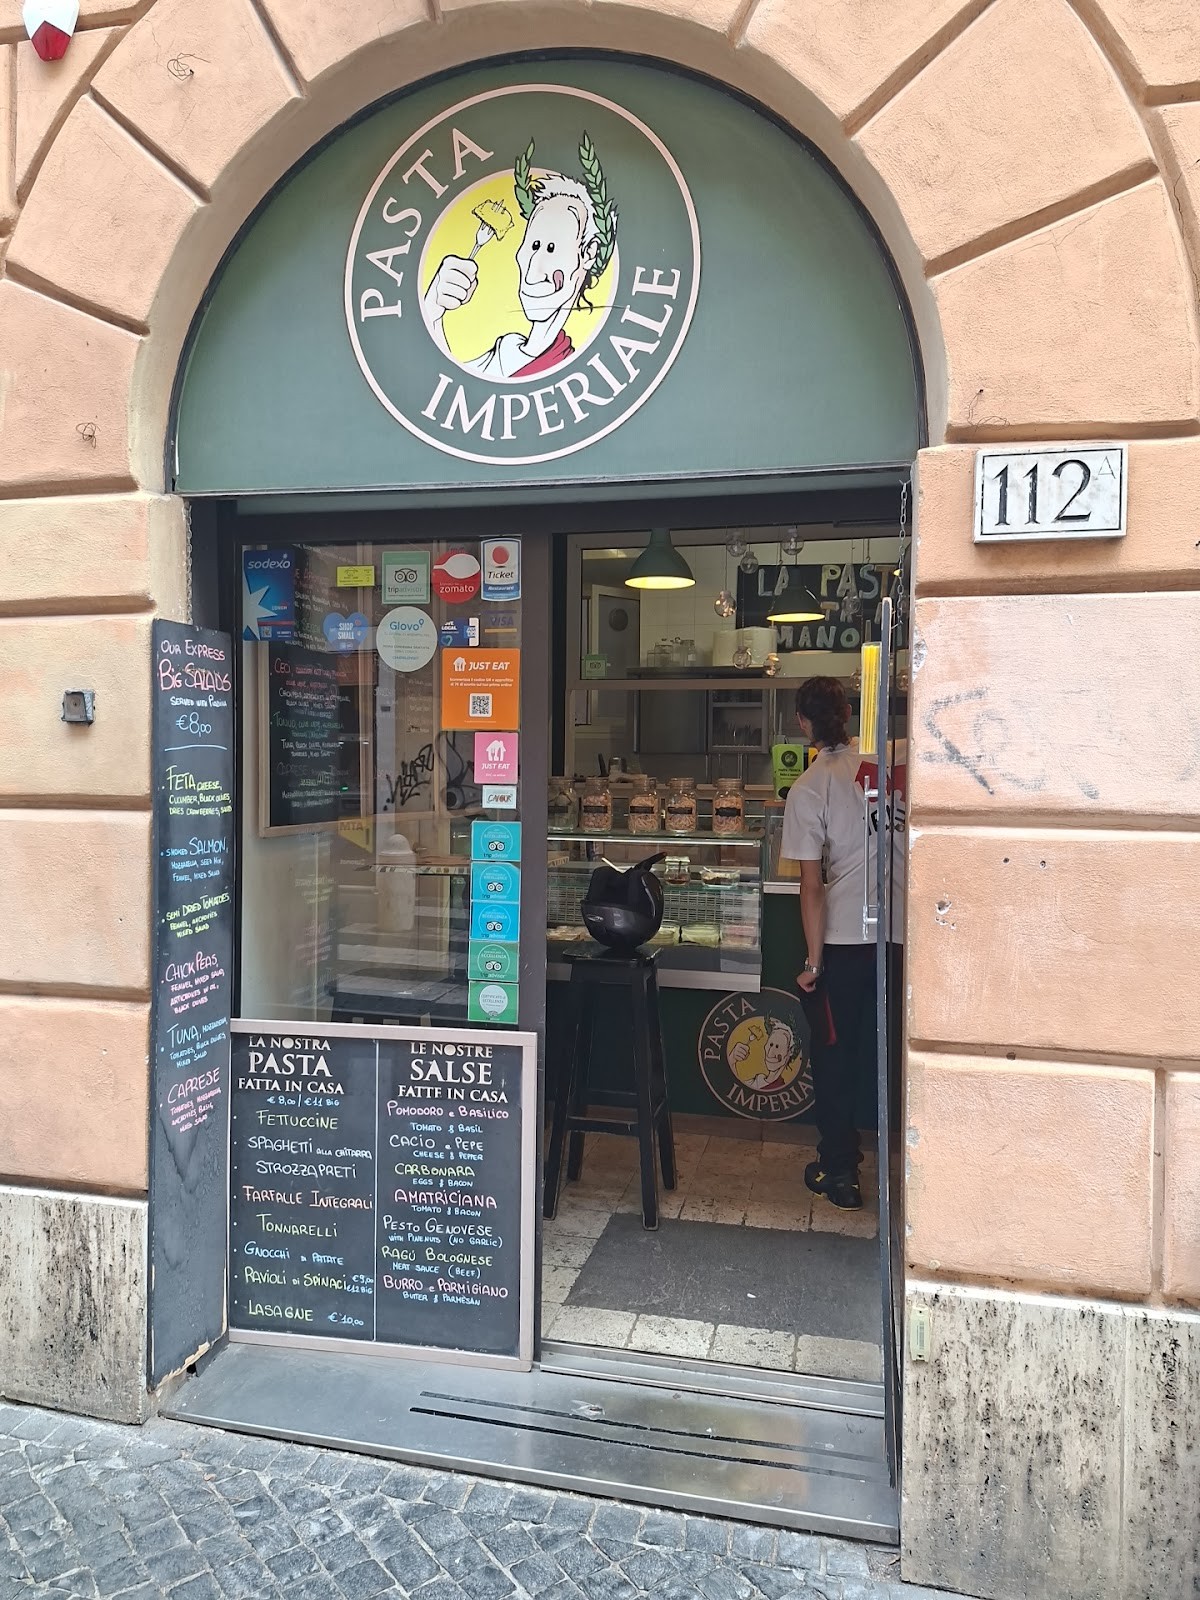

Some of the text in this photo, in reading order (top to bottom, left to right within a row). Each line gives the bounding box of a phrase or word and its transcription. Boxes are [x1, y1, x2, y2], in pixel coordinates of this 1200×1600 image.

[360, 127, 494, 322] PASTA
[421, 265, 681, 442] IMPERIALE
[247, 557, 291, 569] sodexo
[487, 570, 514, 580] Ticket
[440, 584, 475, 594] zomato
[338, 622, 354, 632] SHOP
[389, 621, 420, 631] Glovo
[491, 616, 515, 626] VISA
[337, 631, 355, 641] SMALL
[185, 639, 226, 661] EXPRESS
[469, 661, 511, 671] JUST EAT
[184, 662, 232, 693] SALADS
[165, 765, 196, 791] FETA
[166, 1023, 202, 1049] TUNA,
[704, 997, 757, 1061] PASTA
[248, 1035, 332, 1051] LA NOSTRA
[410, 1042, 493, 1059] LE NOSTRE
[248, 1051, 334, 1077] PASTA
[410, 1059, 492, 1085] SALSE
[167, 1067, 220, 1104] CAPRESE
[238, 1077, 345, 1095] FATTA IN CASA
[447, 1087, 465, 1100] IN
[470, 1089, 509, 1104] CASA
[386, 1100, 444, 1117] POMODORO
[409, 1121, 443, 1132] TOMATO
[447, 1124, 455, 1134] &
[455, 1136, 484, 1151] PEPE
[412, 1150, 484, 1161] CHEESE & PEPPER
[394, 1162, 476, 1177] CARBONARA
[412, 1178, 474, 1188] EGGS & BACON
[242, 1185, 303, 1205] FARFALLE
[410, 1204, 482, 1217] TOMATO & BACON
[382, 1214, 493, 1237] PESTO GENOVESE
[312, 1252, 344, 1266] PATATE
[425, 1247, 493, 1267] BOLOGNESE
[392, 1261, 411, 1271] MEAT
[415, 1264, 440, 1274] SAUCE
[382, 1274, 424, 1291] BURRO
[402, 1291, 428, 1302] BUTTER
[442, 1293, 481, 1306] PARMESAN
[248, 1299, 314, 1322] LASAGNE
